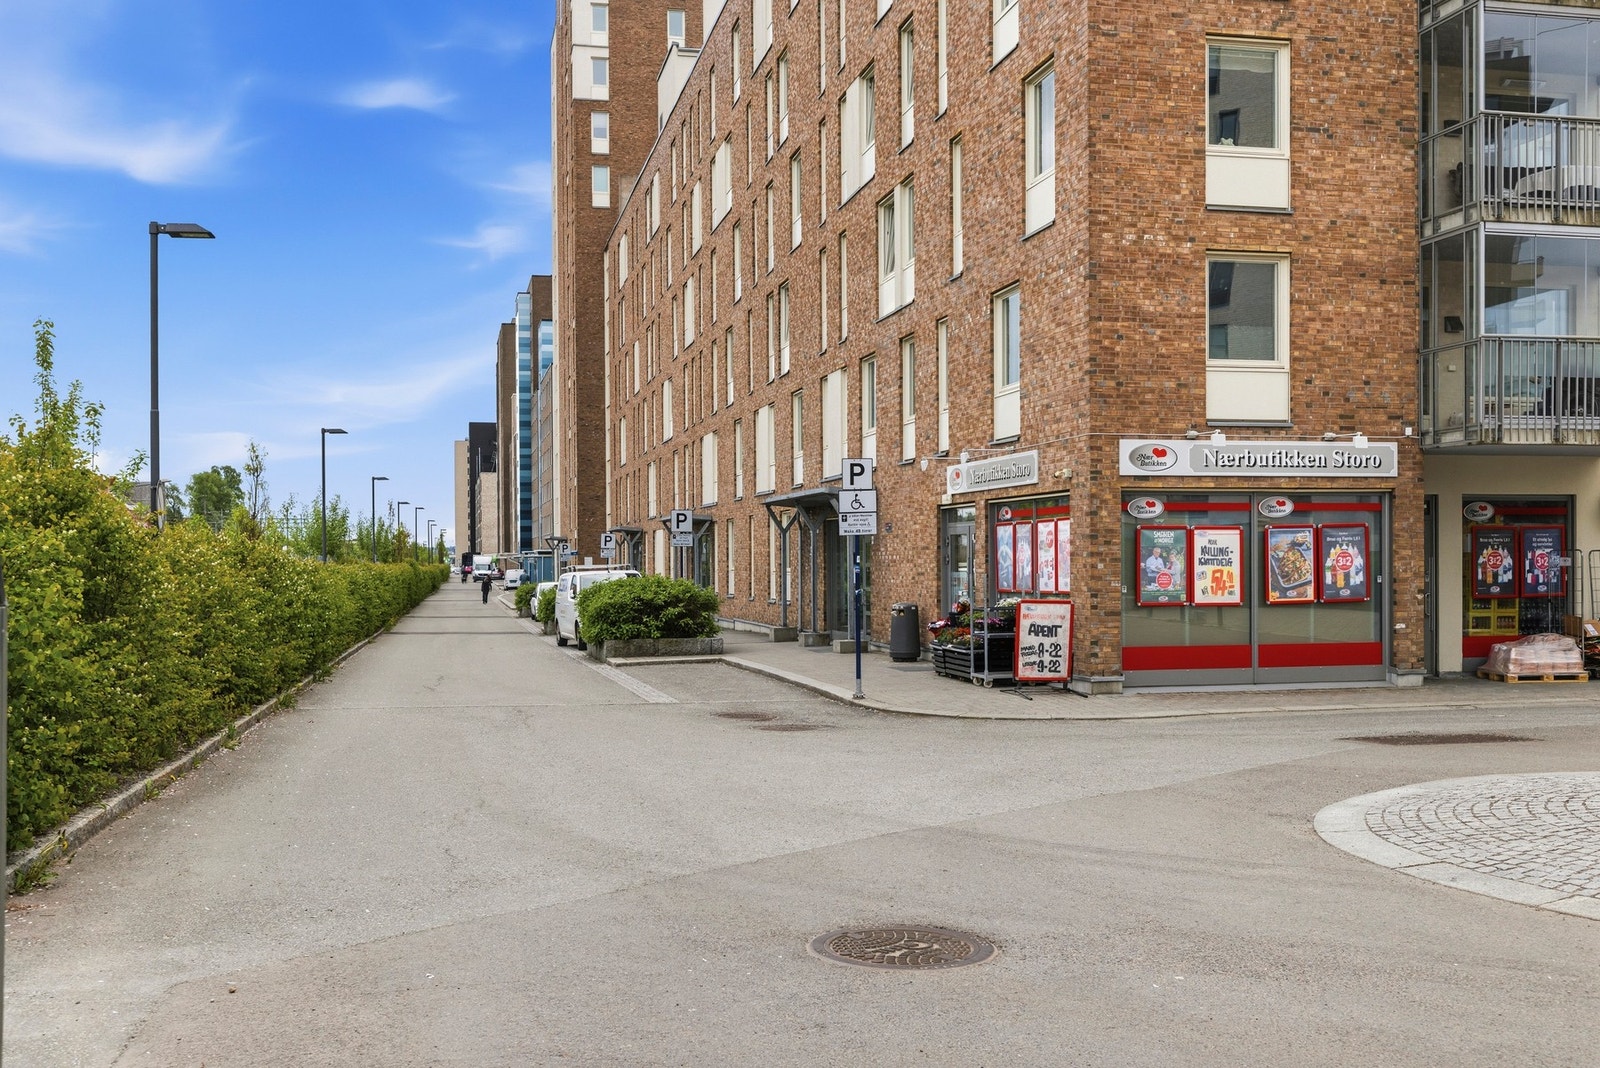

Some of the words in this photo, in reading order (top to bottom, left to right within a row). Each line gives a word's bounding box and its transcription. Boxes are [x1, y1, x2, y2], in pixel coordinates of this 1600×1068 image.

[1136, 453, 1154, 461] Nær
[1202, 449, 1328, 468] Nærbutikken
[1332, 450, 1382, 468] Storo
[850, 462, 865, 486] P
[1012, 461, 1031, 479] Storo
[676, 513, 687, 529] P
[562, 544, 568, 552] P
[604, 536, 612, 546] P
[1028, 621, 1062, 638] ÅPENT
[1037, 660, 1061, 673] 9-22
